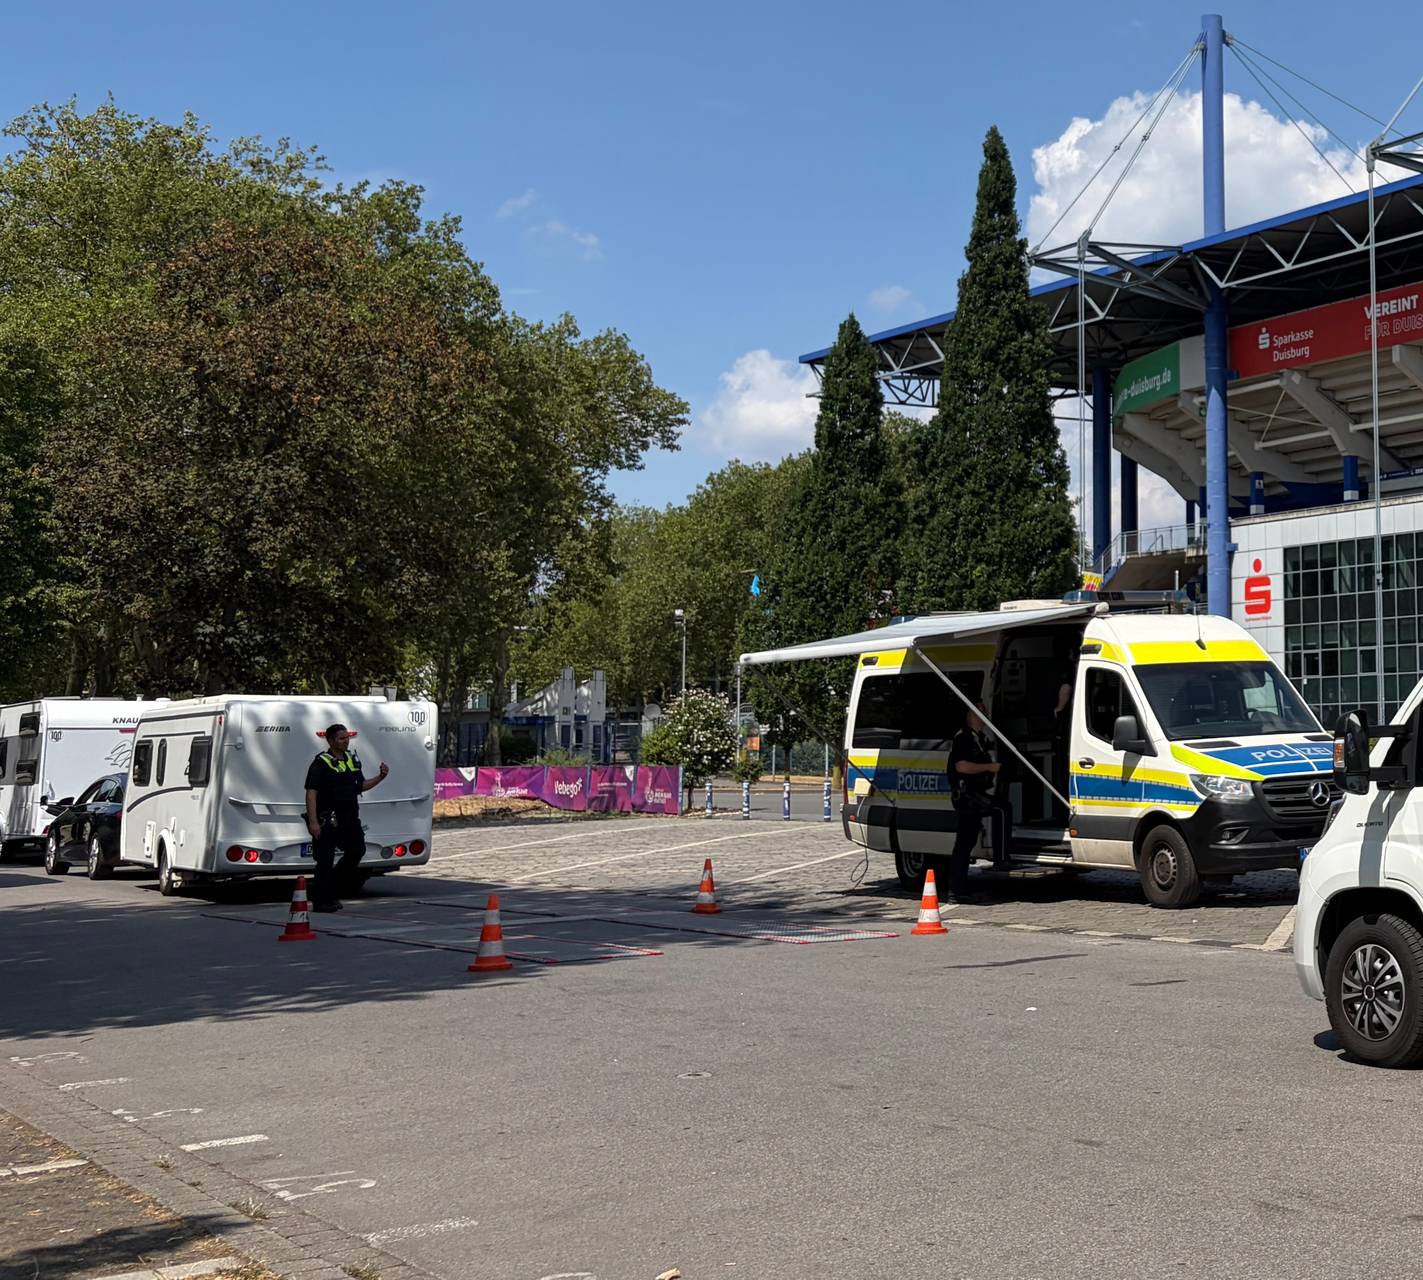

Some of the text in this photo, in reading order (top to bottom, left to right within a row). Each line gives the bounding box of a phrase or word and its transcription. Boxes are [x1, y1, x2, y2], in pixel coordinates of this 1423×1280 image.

[1364, 295, 1419, 319] VEREINT
[1272, 328, 1314, 347] Sparkasse
[1273, 344, 1310, 362] Duisburg
[411, 711, 426, 723] 100
[1250, 746, 1334, 762] POLIZEI
[554, 780, 579, 798] Vebego
[898, 773, 939, 791] POLIZEI
